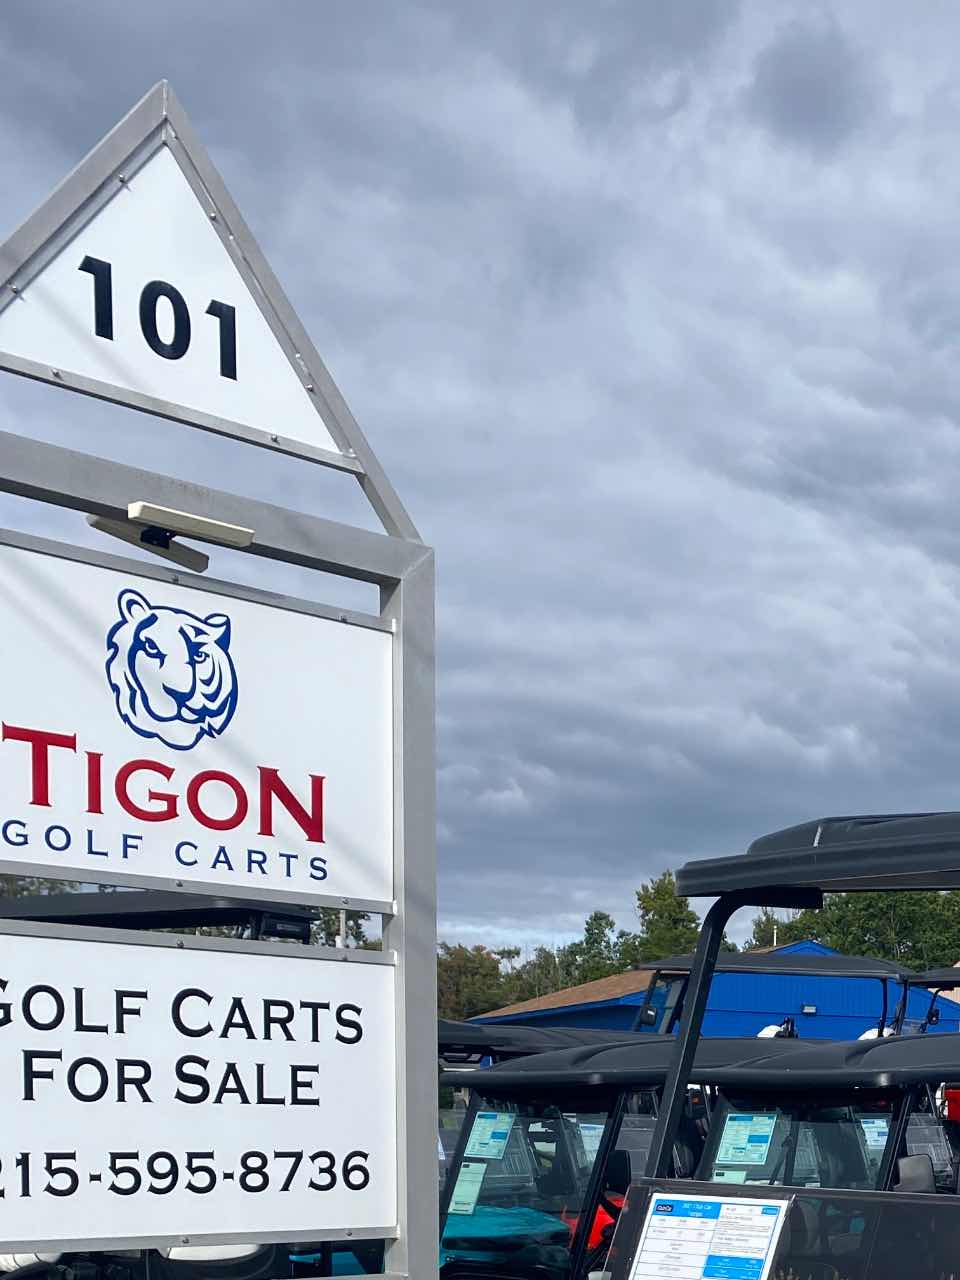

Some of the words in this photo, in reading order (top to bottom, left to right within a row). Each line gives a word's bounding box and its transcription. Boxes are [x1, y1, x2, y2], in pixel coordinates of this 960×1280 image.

[78, 254, 237, 381] 101
[2, 721, 326, 843] TIGON
[2, 819, 143, 859] GOLF
[174, 840, 329, 881] CARTS
[0, 978, 148, 1035] OLF
[171, 987, 364, 1045] CARTS
[21, 1048, 153, 1103] FOR
[174, 1054, 320, 1106] SALE
[0, 1150, 370, 1198] 15-595-8736
